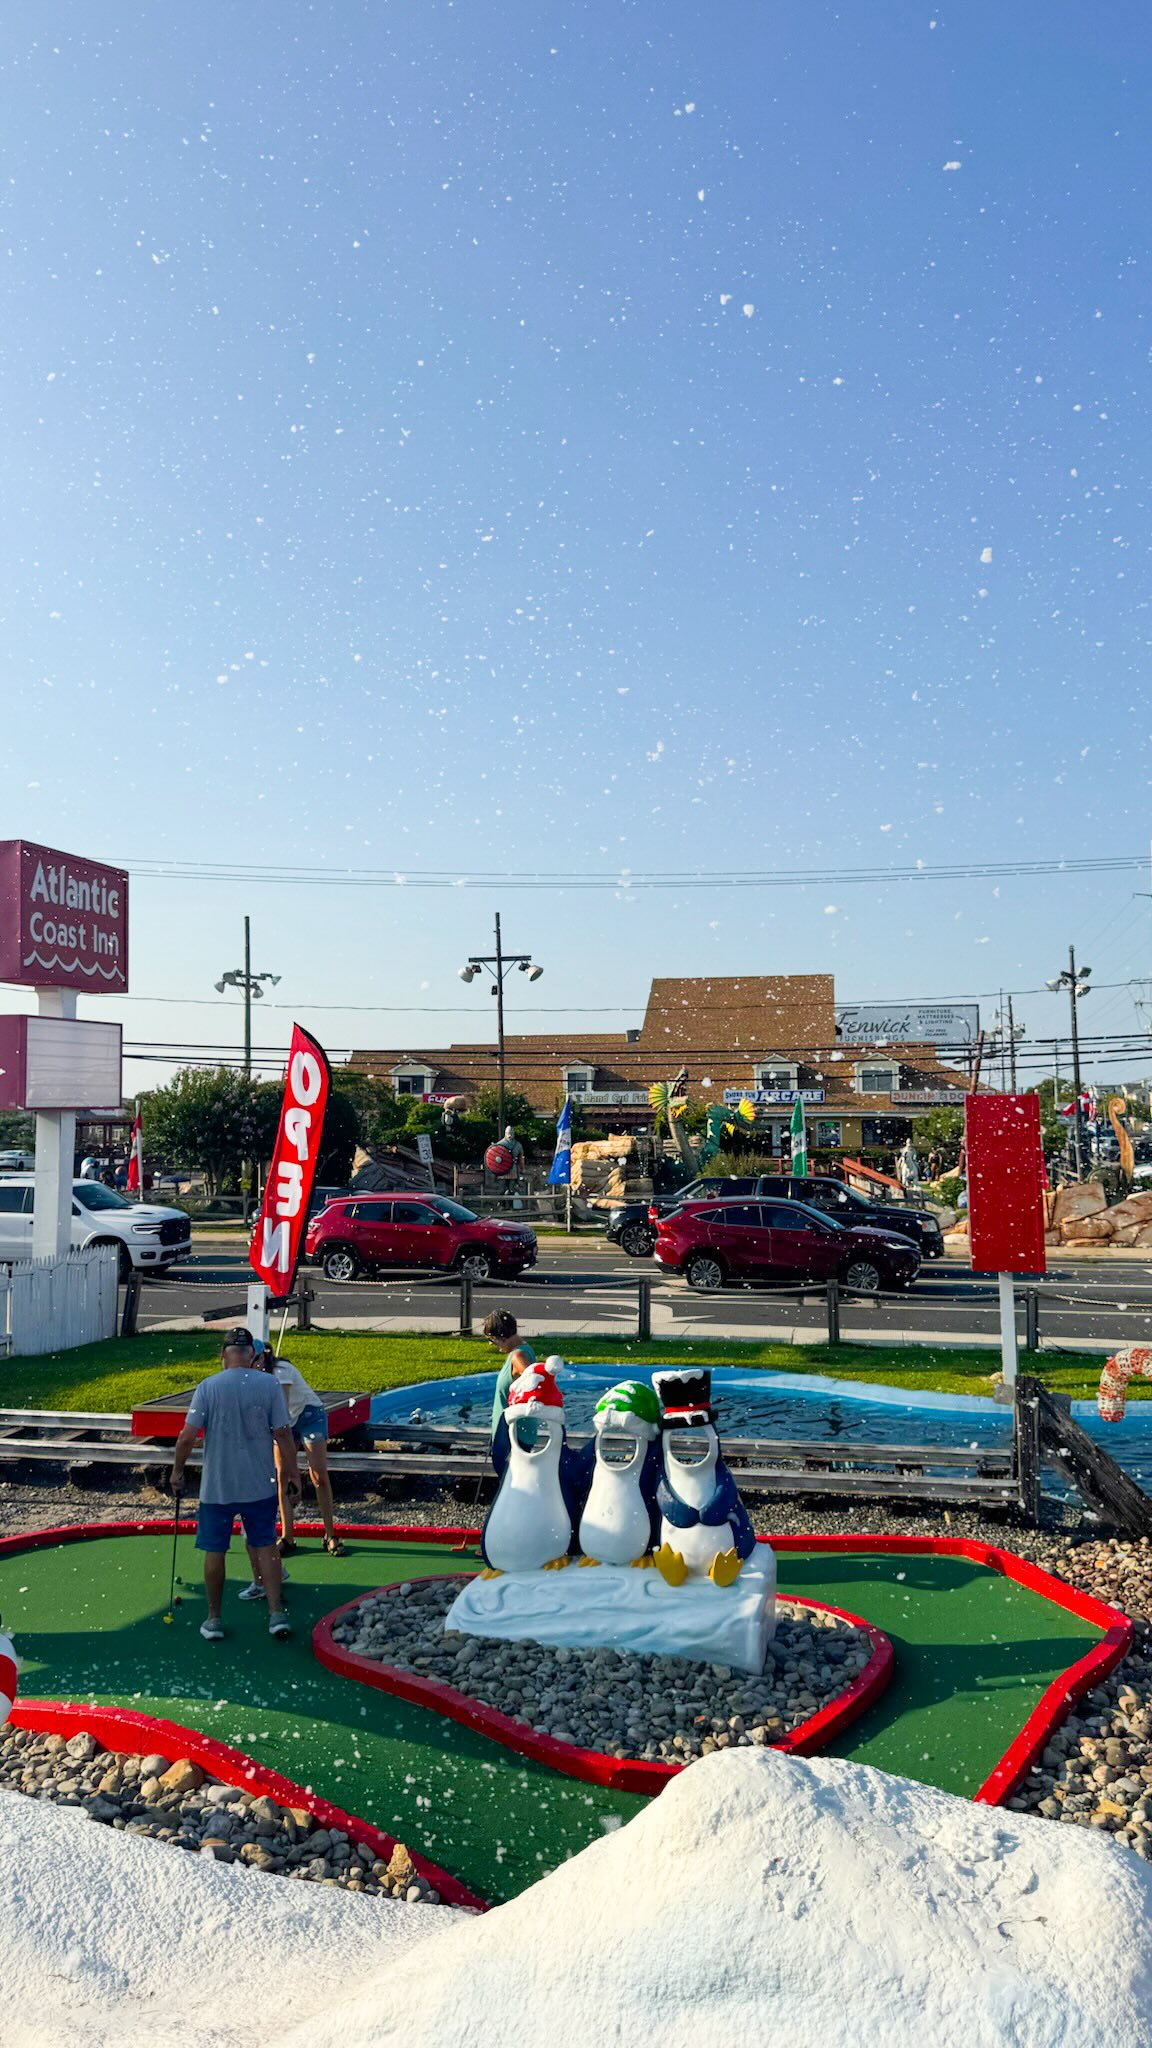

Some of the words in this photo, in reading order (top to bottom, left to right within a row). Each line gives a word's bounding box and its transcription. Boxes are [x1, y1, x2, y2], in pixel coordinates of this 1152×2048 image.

[30, 859, 119, 919] Atlantic
[30, 911, 87, 951] Coast
[92, 923, 119, 957] Inn
[759, 1091, 822, 1101] ARCADE
